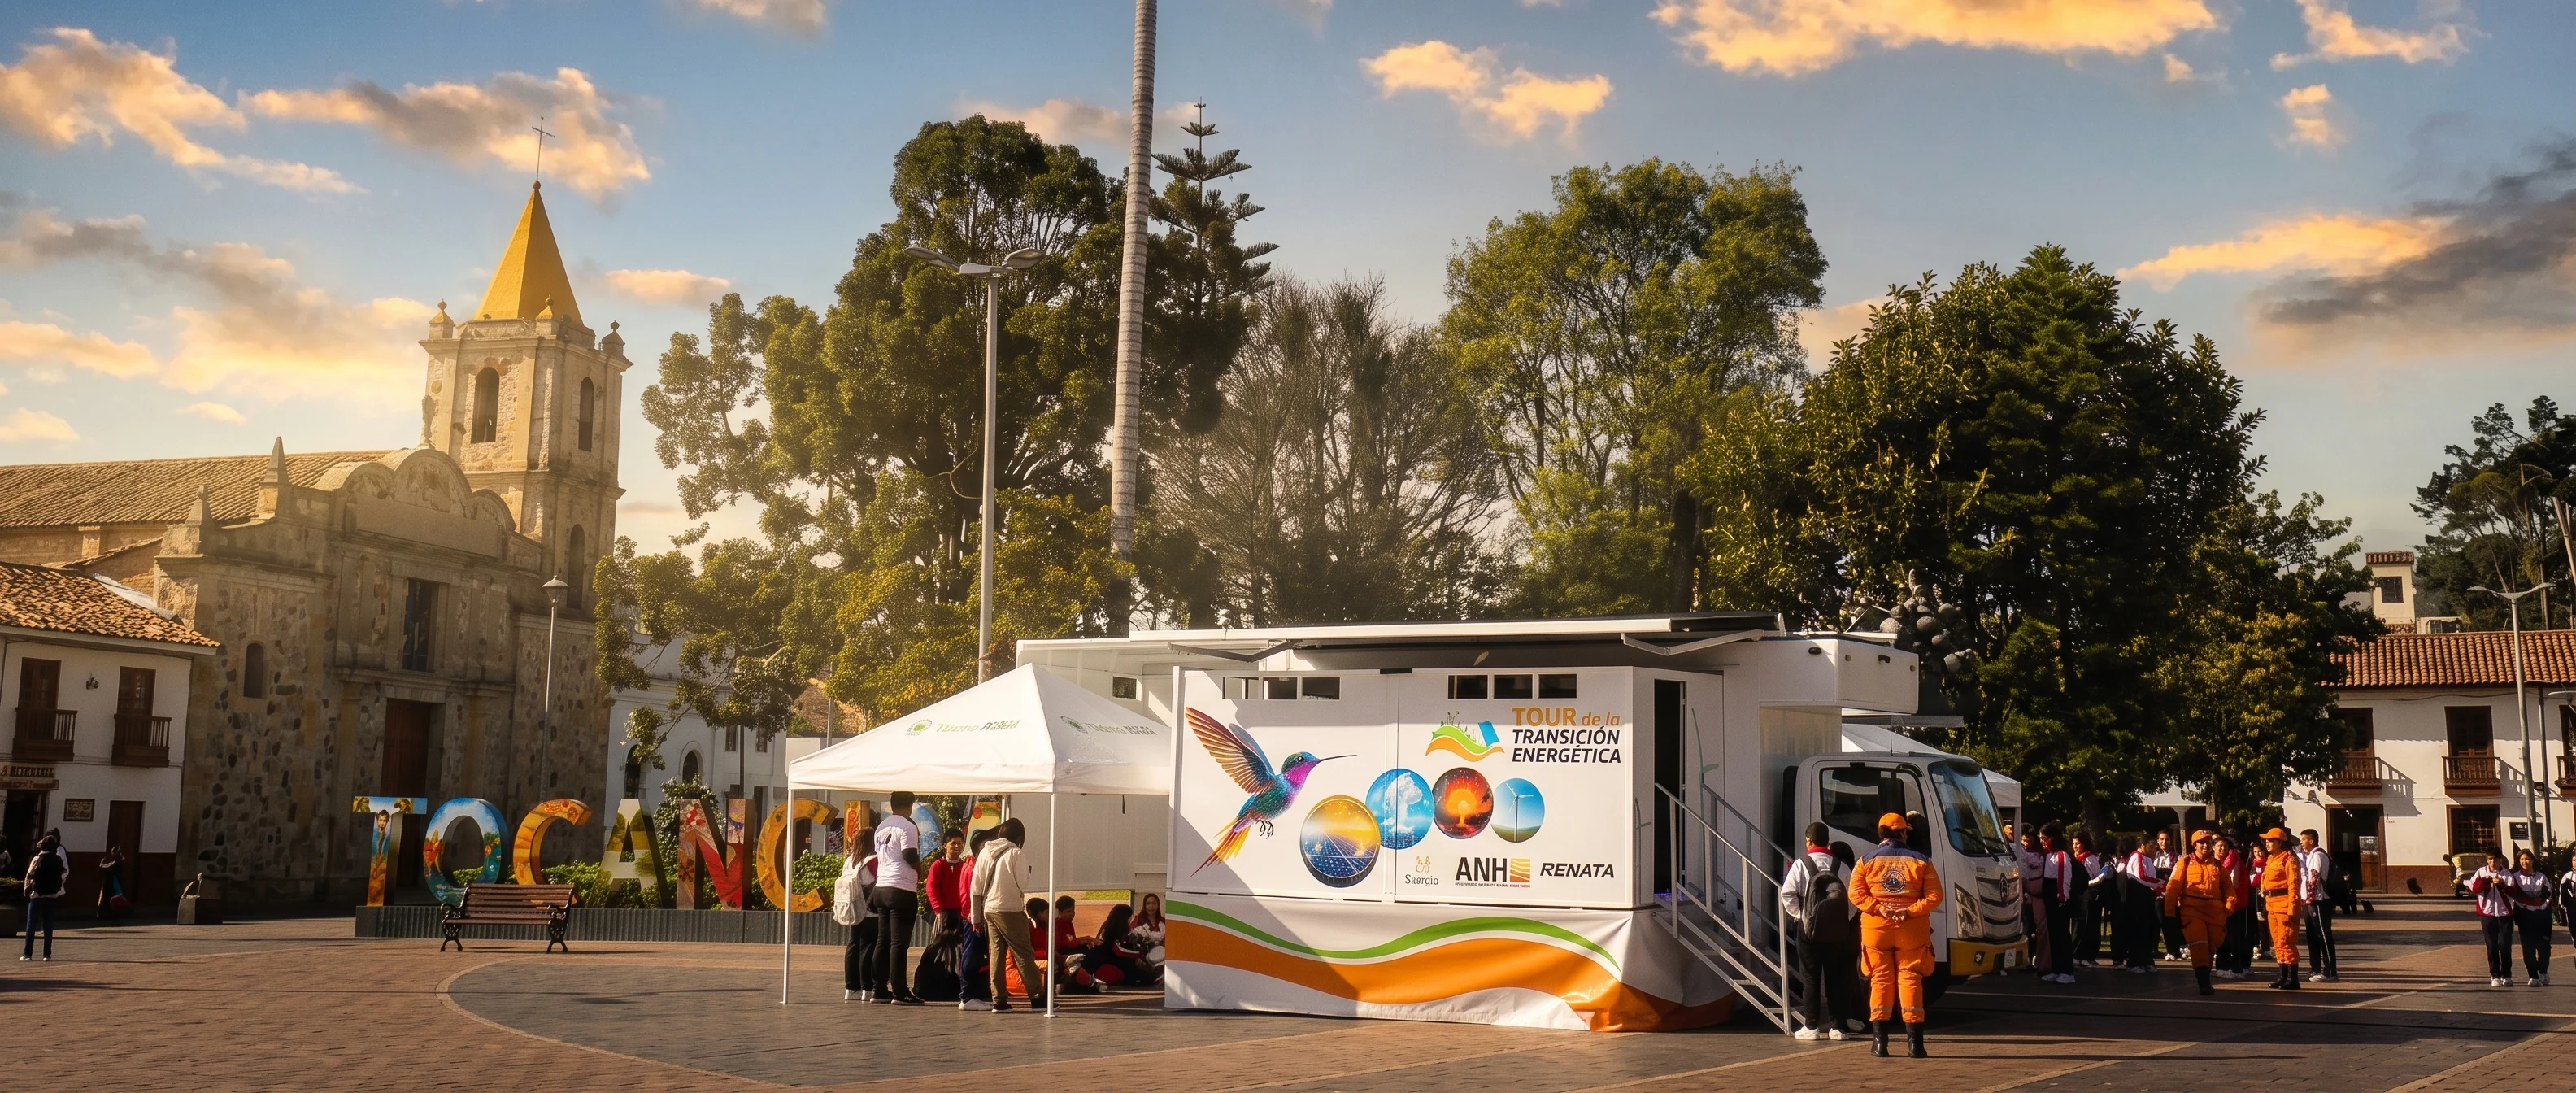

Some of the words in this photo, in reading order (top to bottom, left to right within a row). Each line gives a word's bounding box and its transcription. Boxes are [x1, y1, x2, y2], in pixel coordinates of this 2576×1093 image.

[1512, 707, 1577, 727] TOUR
[1581, 712, 1601, 726] de
[1605, 712, 1621, 726] la
[1512, 726, 1621, 745] TRANSICIÓN
[1512, 745, 1621, 764] ENERGÉTICA
[1455, 856, 1508, 882] ANH
[1539, 862, 1615, 878] RENATA
